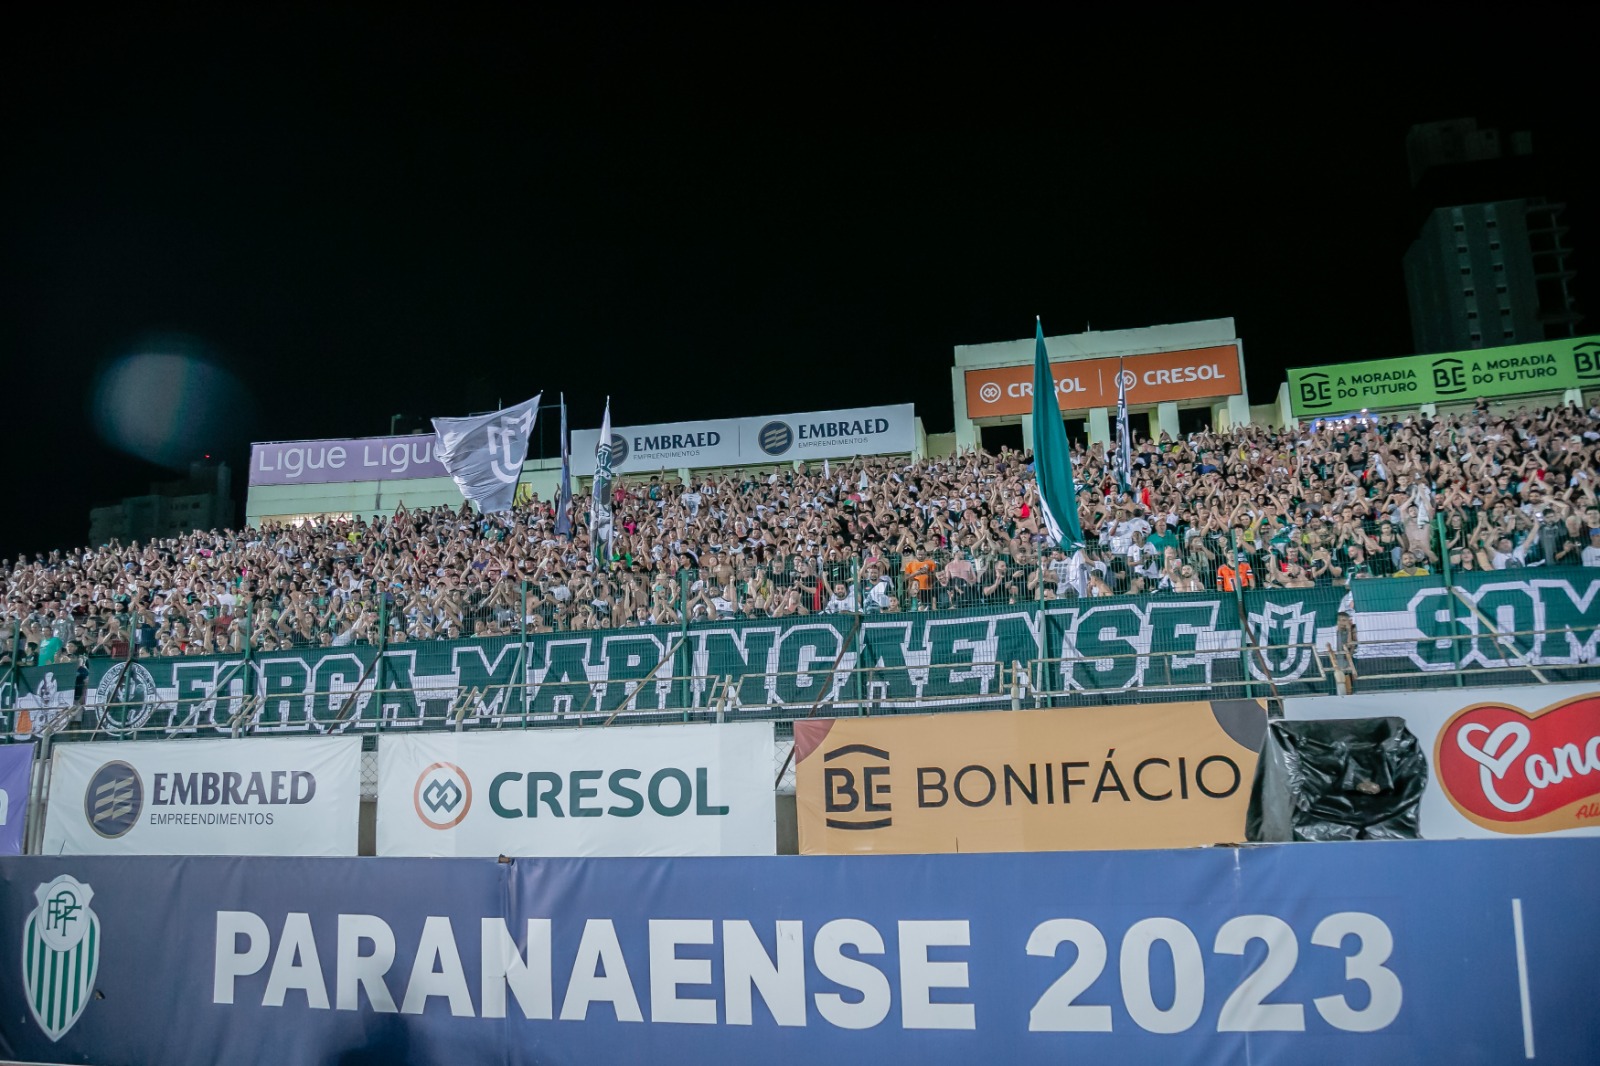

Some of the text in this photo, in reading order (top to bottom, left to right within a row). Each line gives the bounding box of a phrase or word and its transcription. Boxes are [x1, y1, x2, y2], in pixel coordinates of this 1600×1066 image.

[1471, 354, 1556, 372] A MORADIA
[1143, 364, 1225, 386] CRESOL
[1337, 369, 1417, 386] A MORADIA
[1433, 366, 1466, 388] BE
[1472, 366, 1557, 385] DO FUTURO
[1007, 377, 1086, 398] CROL
[1300, 381, 1332, 401] BE
[1337, 381, 1417, 399] DO FUTURO
[798, 418, 890, 439] EMBRAED
[633, 431, 721, 452] EMBRAED
[798, 437, 869, 449] EMPREENDIMENTOS
[259, 446, 347, 478] Ligue
[633, 449, 701, 460] EMPREENDIMENTOS
[151, 770, 316, 806] EMBRAED
[824, 748, 1242, 813] BE BONIFÁCIO
[488, 767, 730, 819] CRESOL
[150, 812, 274, 826] EMPREENDIMENTOS
[213, 910, 1403, 1034] PARANAENSE 2023
